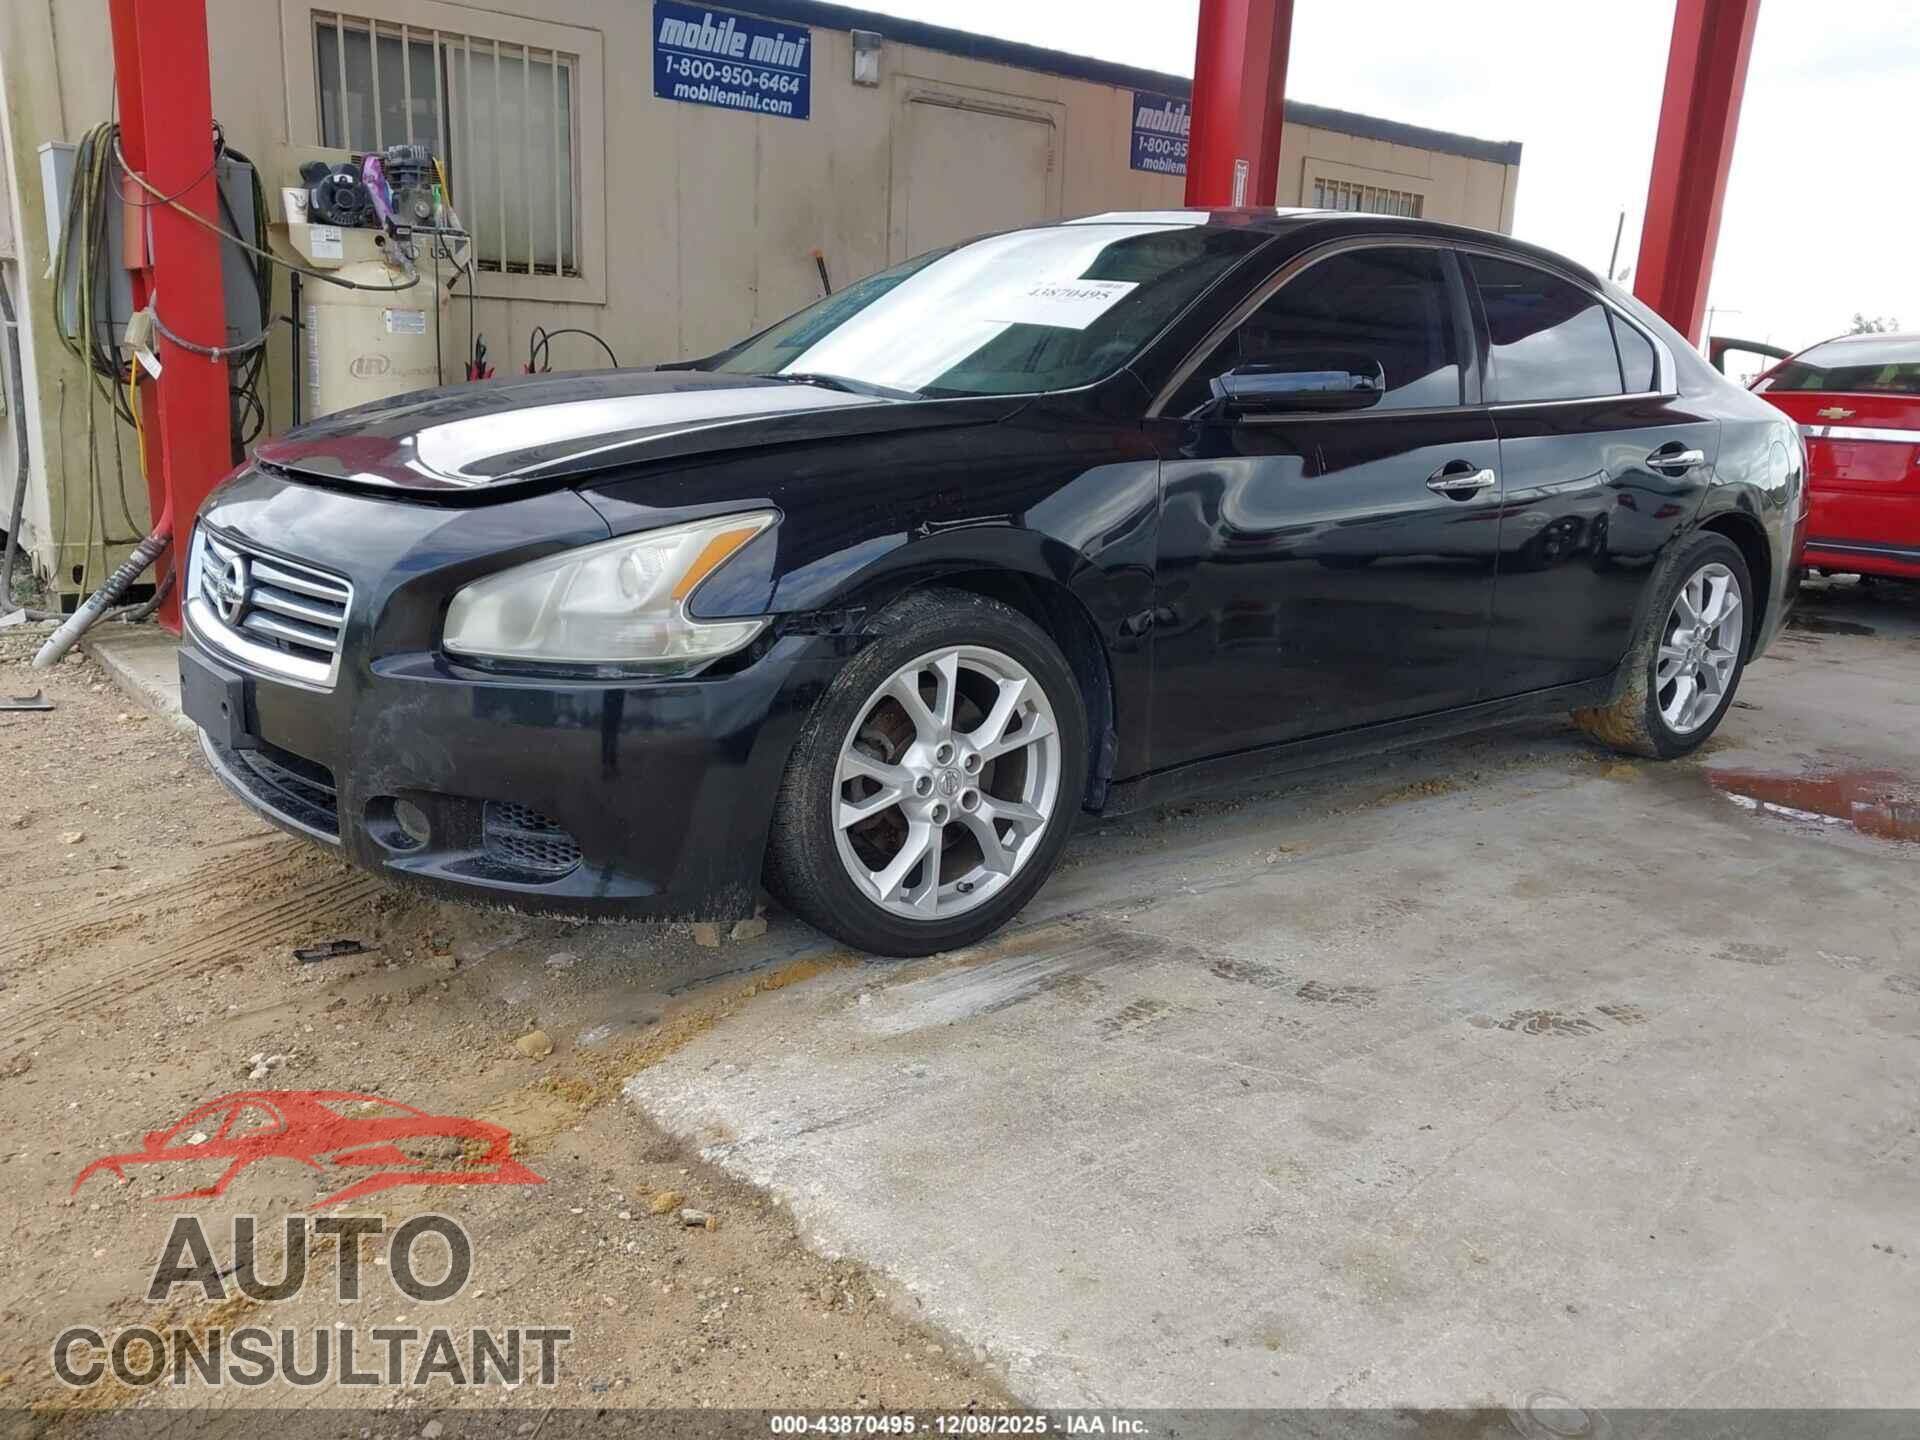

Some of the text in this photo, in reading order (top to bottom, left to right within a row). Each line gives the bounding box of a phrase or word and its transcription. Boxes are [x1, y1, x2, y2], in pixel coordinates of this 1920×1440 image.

[658, 13, 807, 68] mobile mini
[665, 56, 800, 95] 1-800-950-6464
[674, 83, 792, 114] mobilemini.com
[1136, 101, 1191, 136] mobile
